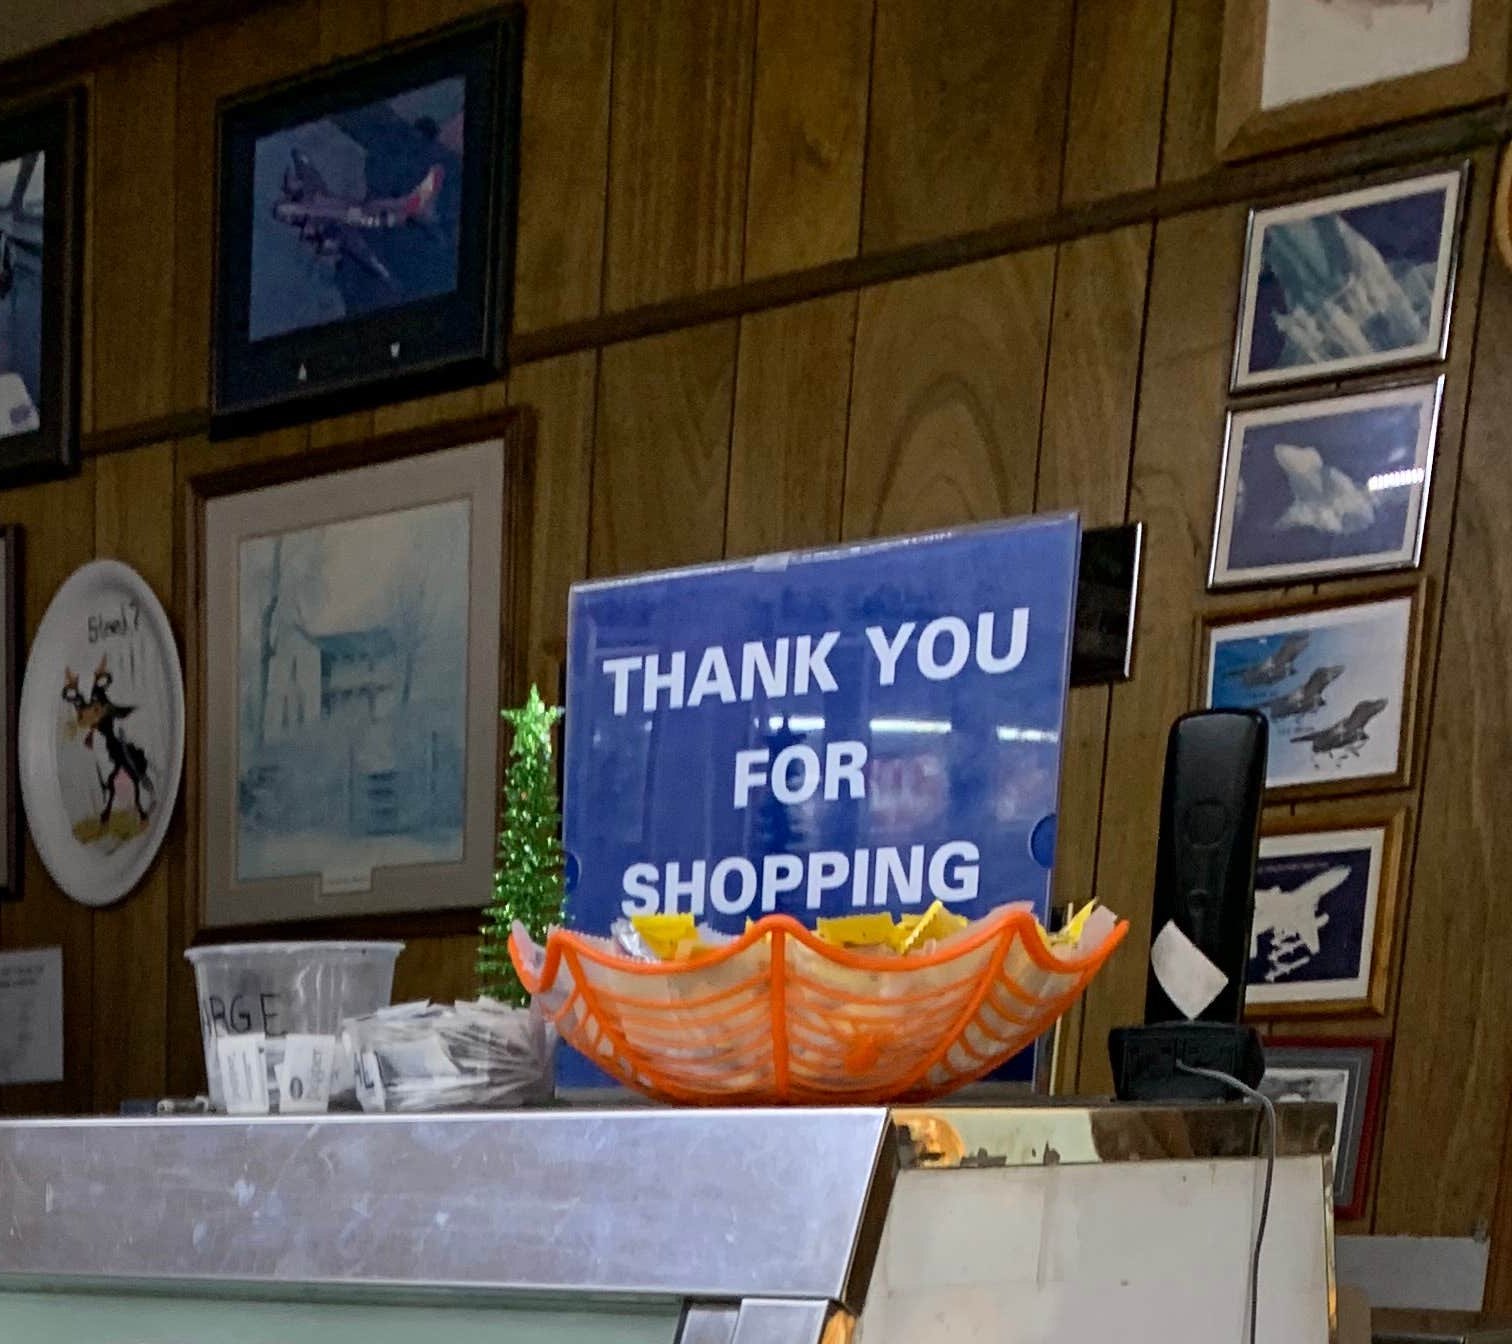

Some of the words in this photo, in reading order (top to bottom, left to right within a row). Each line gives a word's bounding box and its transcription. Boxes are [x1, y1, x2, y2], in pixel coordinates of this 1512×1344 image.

[601, 631, 842, 716] THANK
[865, 607, 1030, 687] YOU
[733, 740, 868, 809] FOR
[620, 840, 982, 919] SHOPPING
